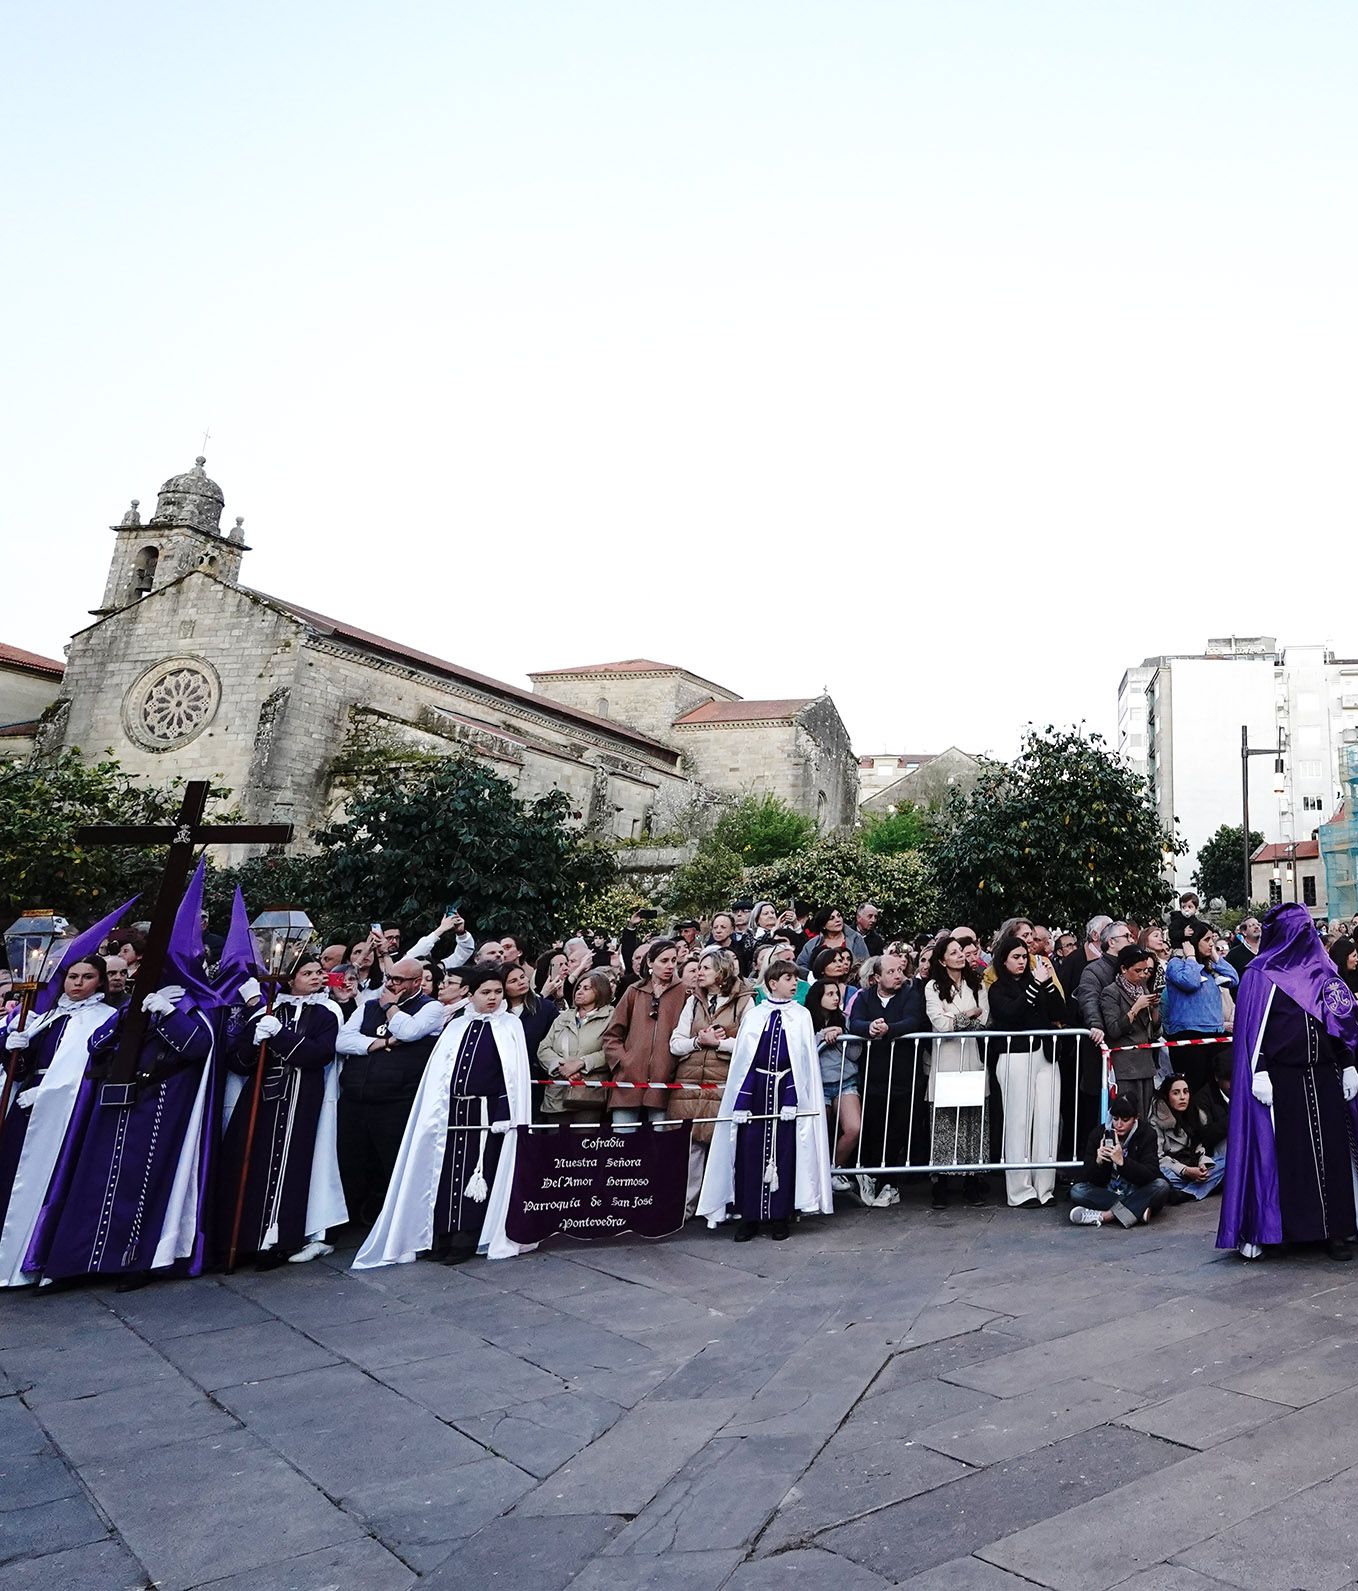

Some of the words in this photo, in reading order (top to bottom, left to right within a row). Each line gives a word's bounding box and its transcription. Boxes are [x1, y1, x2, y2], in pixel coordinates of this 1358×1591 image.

[554, 1157, 598, 1169] Nuestra
[605, 1157, 642, 1168] Señora
[606, 1176, 649, 1187] Hermoso
[591, 1196, 602, 1207] de
[611, 1197, 630, 1208] San
[632, 1196, 653, 1209] José
